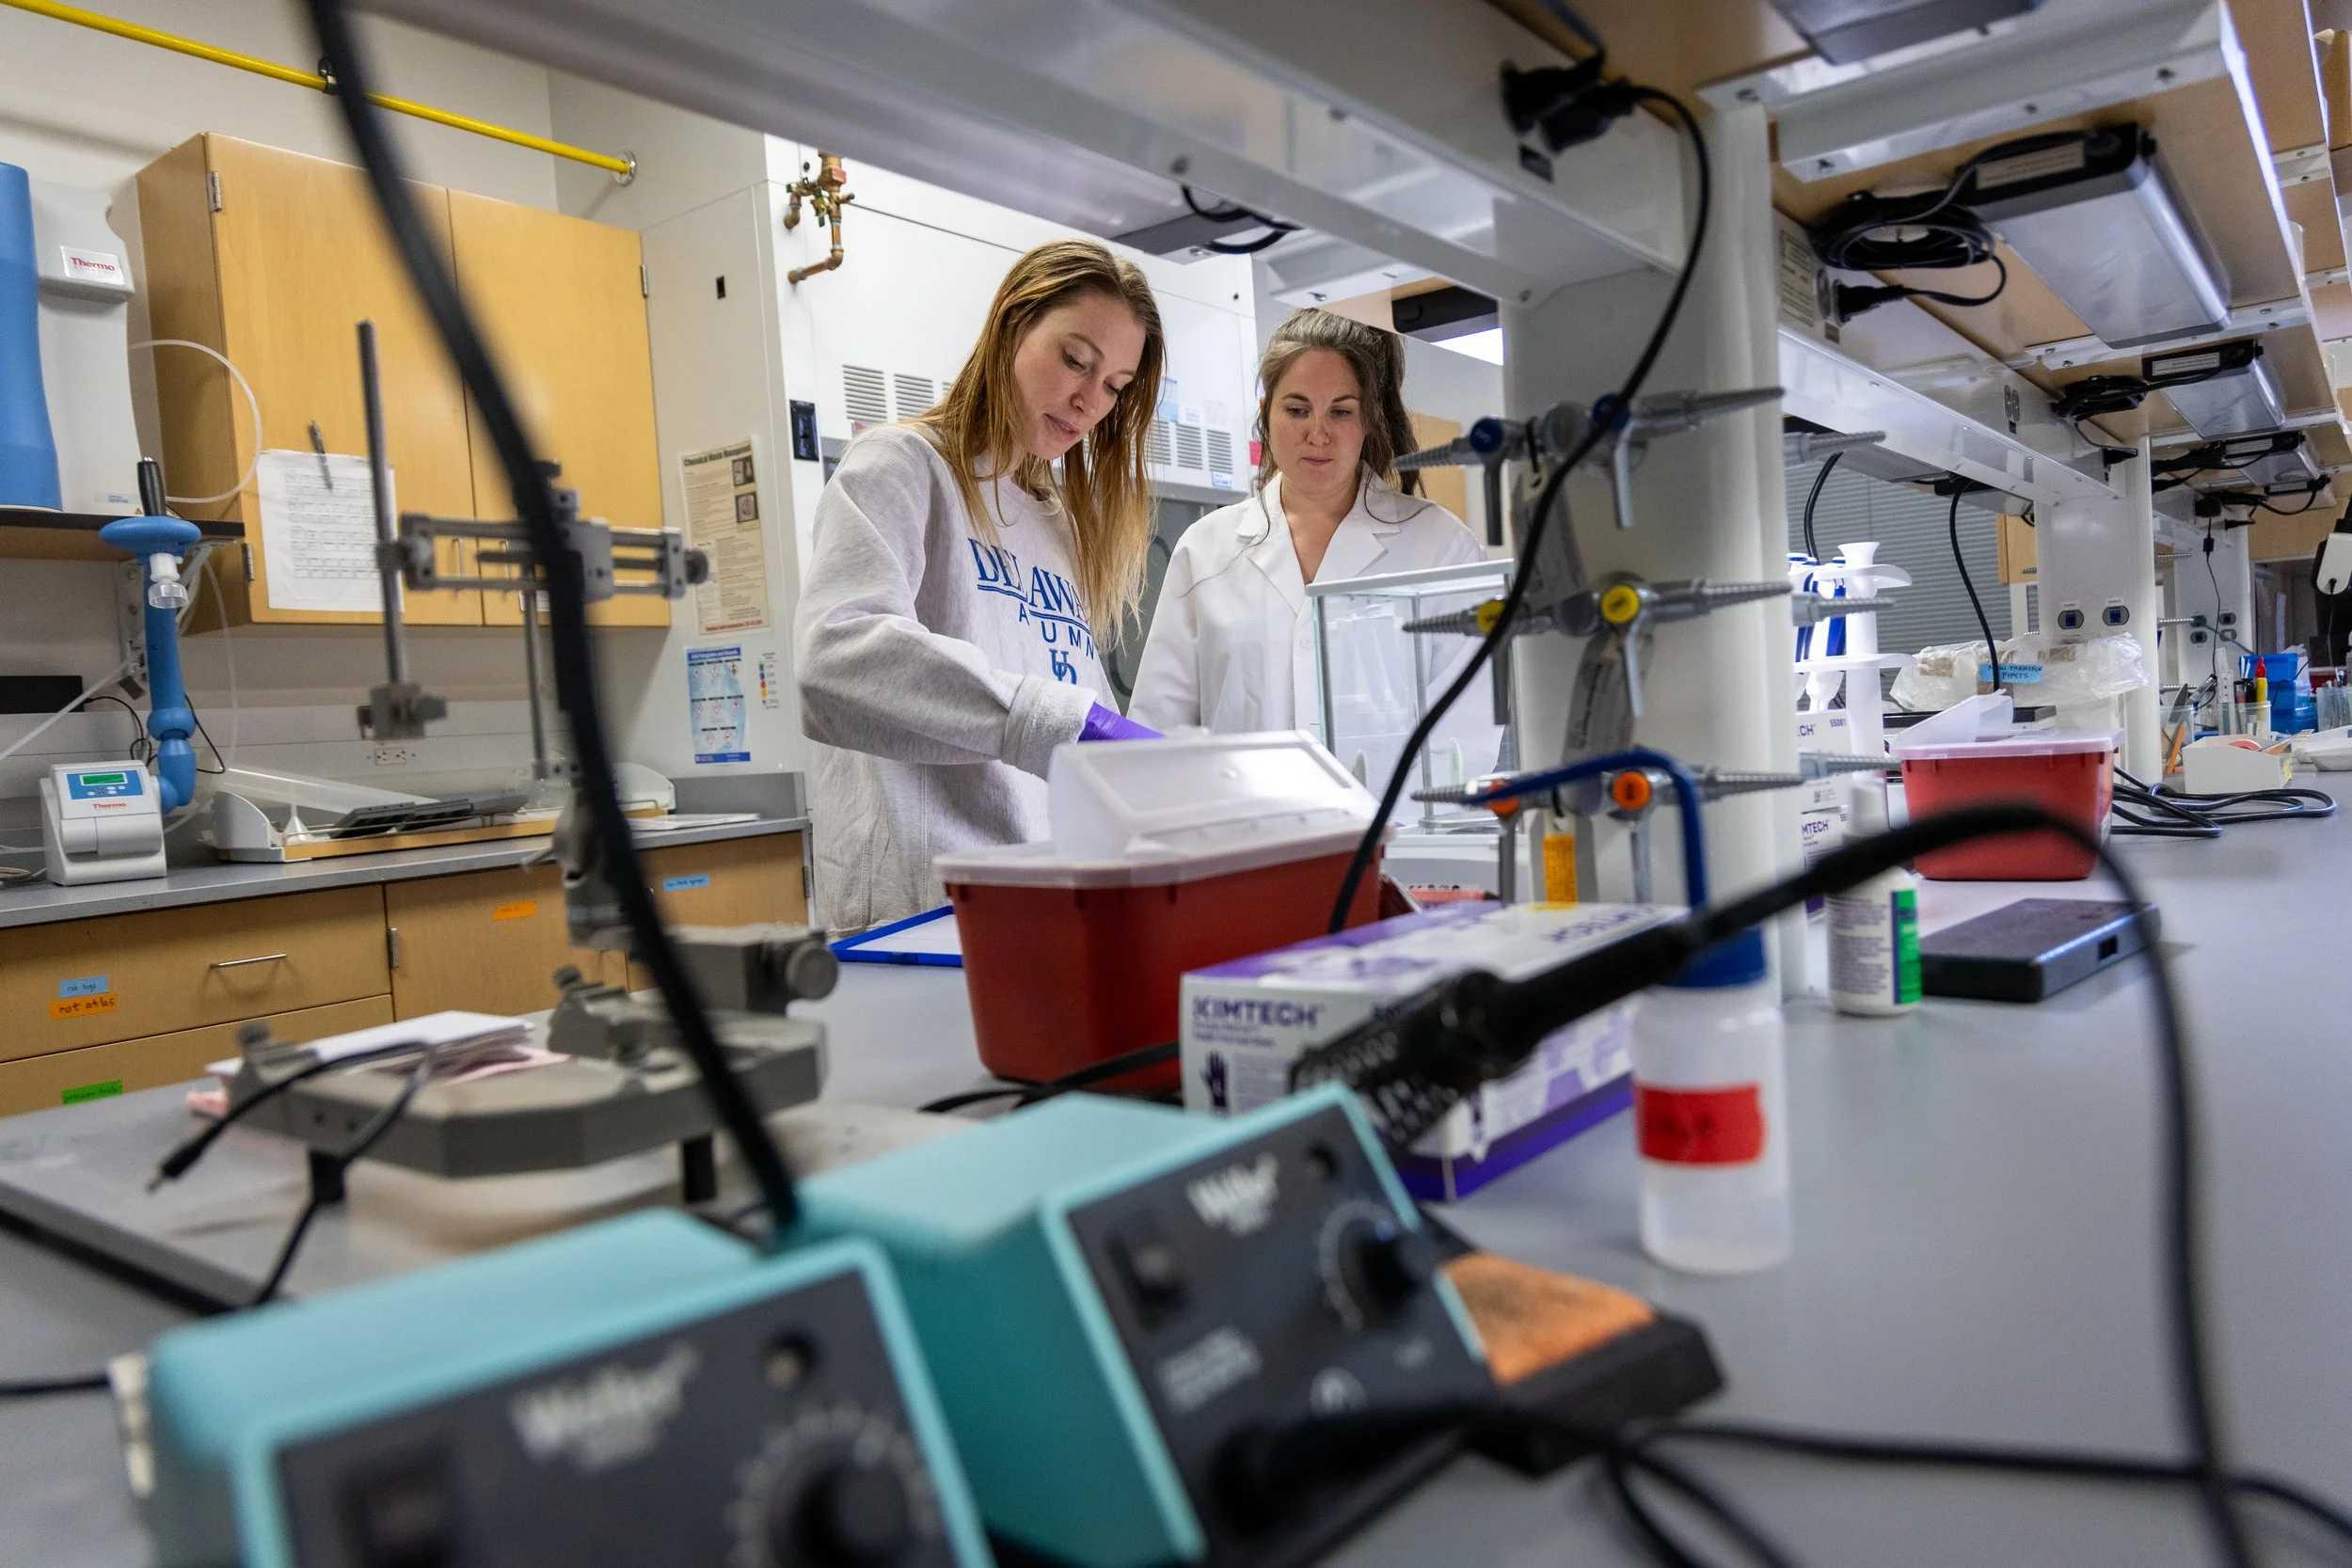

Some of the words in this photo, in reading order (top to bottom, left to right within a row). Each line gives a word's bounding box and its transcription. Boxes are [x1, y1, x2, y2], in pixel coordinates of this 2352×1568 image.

[70, 256, 115, 271] Thermo
[968, 538, 1092, 625] DELAWA
[1019, 603, 1094, 659] AUMN
[1802, 819, 1830, 835] MTECH
[59, 1002, 81, 1013] rat
[86, 997, 115, 1009] atlas
